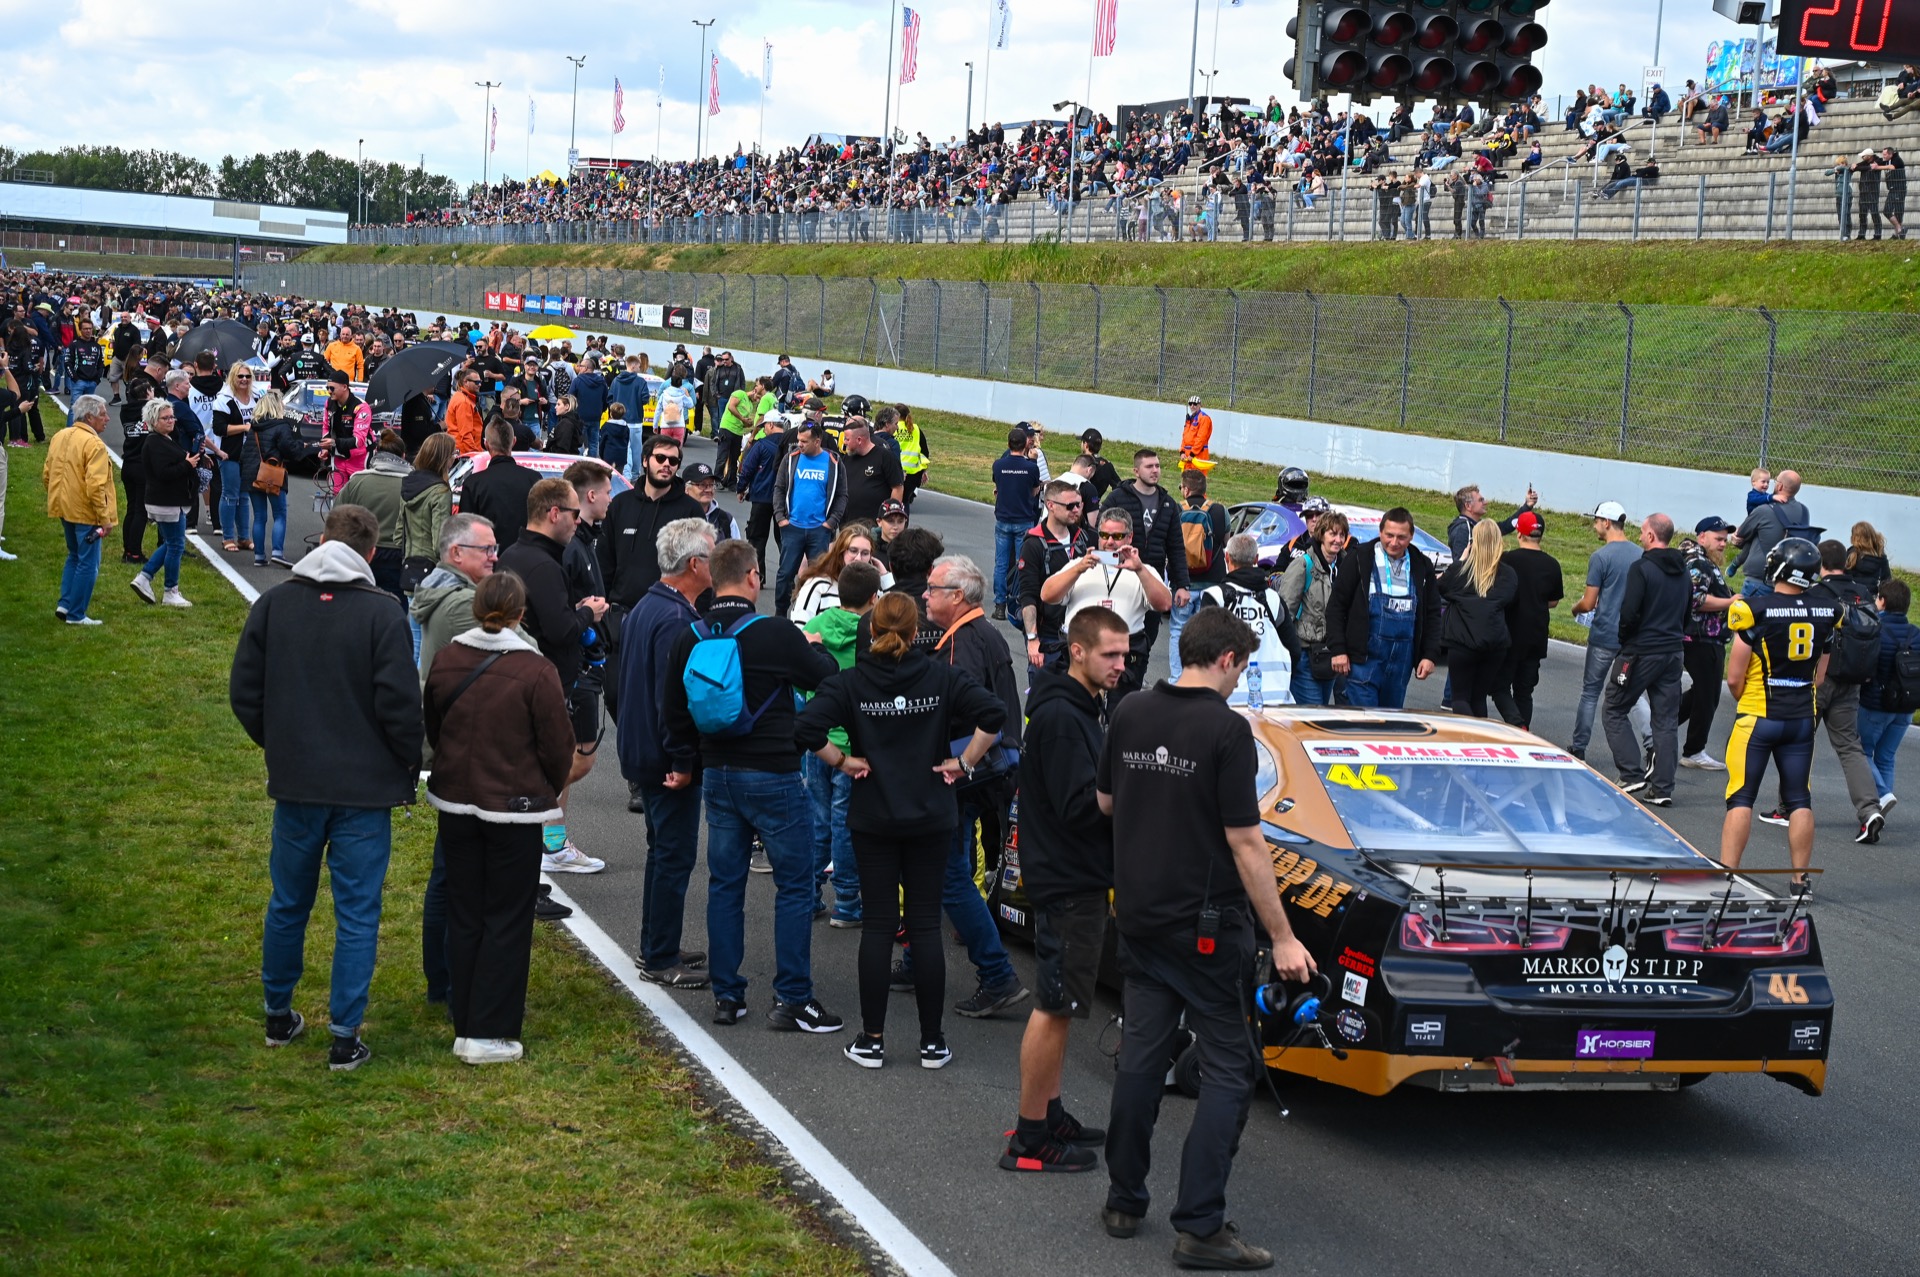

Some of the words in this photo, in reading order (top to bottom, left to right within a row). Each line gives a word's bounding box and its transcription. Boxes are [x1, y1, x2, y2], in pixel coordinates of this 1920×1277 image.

[1646, 69, 1663, 77] EXIT
[194, 395, 217, 404] MEDI
[516, 461, 568, 470] WHELE
[796, 468, 826, 481] VANS
[1765, 607, 1809, 618] MOUNTAIN
[1788, 622, 1815, 662] 8
[860, 701, 894, 709] MARKO
[908, 695, 940, 706] STIPP
[1122, 751, 1155, 762] MARKO
[1362, 743, 1520, 759] WHELEN
[1325, 764, 1398, 791] 46
[1001, 904, 1018, 922] Mobil
[1343, 946, 1375, 966] Spedition
[1338, 955, 1375, 978] GERBER
[1522, 957, 1600, 976] MARKO
[1630, 958, 1704, 976] STIPP
[1343, 976, 1362, 995] MCC
[1768, 973, 1810, 1004] 46
[1345, 1016, 1362, 1030] NASCAR
[1599, 1040, 1652, 1049] HOOSIER
